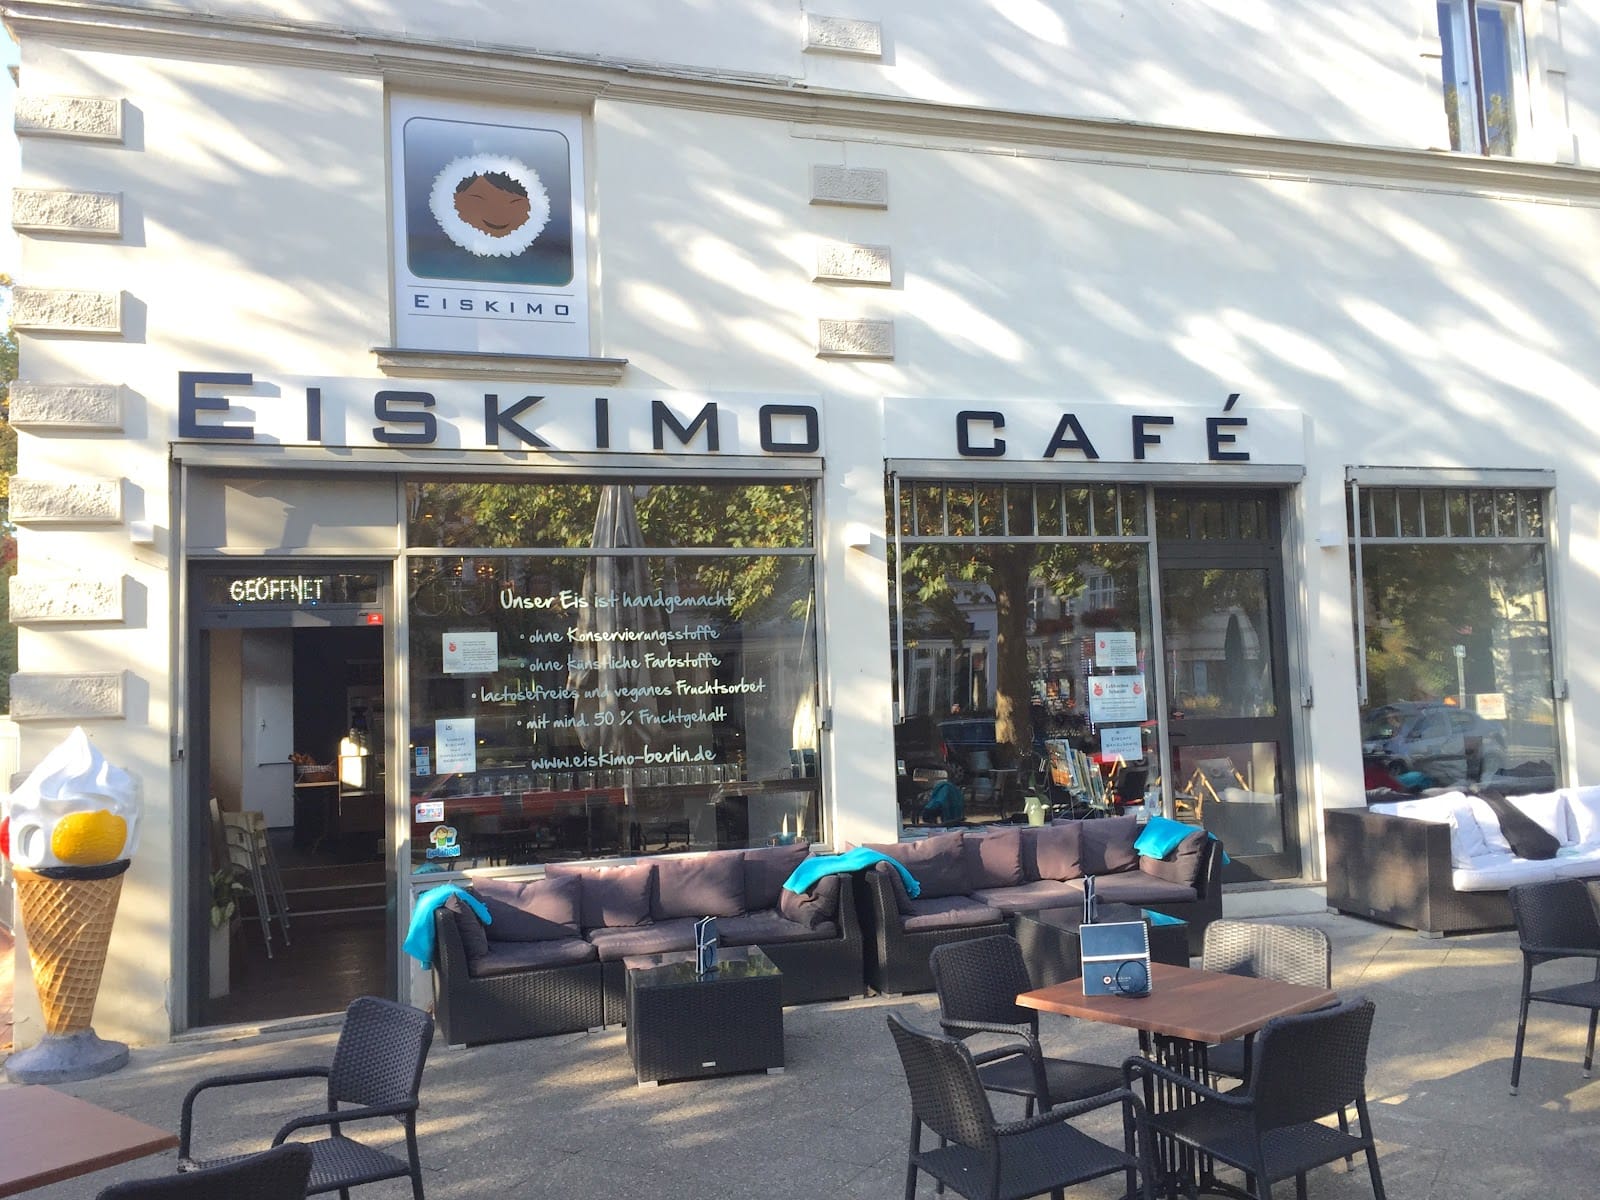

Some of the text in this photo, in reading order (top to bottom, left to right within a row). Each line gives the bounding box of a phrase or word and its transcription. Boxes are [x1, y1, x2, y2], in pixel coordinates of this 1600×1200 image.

[414, 294, 569, 316] EISKIMO
[178, 371, 1251, 461] EISKIMO CAFÉ
[230, 577, 323, 601] GEÖFFNET
[500, 588, 738, 614] Unser Eis ist handgemacht
[529, 624, 720, 647] ohne Konservierungsstoffe
[529, 657, 563, 672] ohne
[644, 652, 722, 669] Farbstoffe
[480, 677, 766, 703] lactosefreies und veganes Fruchtsorbet
[526, 706, 728, 730] mit mind. 50 % Fruchtgehalt
[531, 744, 717, 771] www.eiskimo-berlin.de
